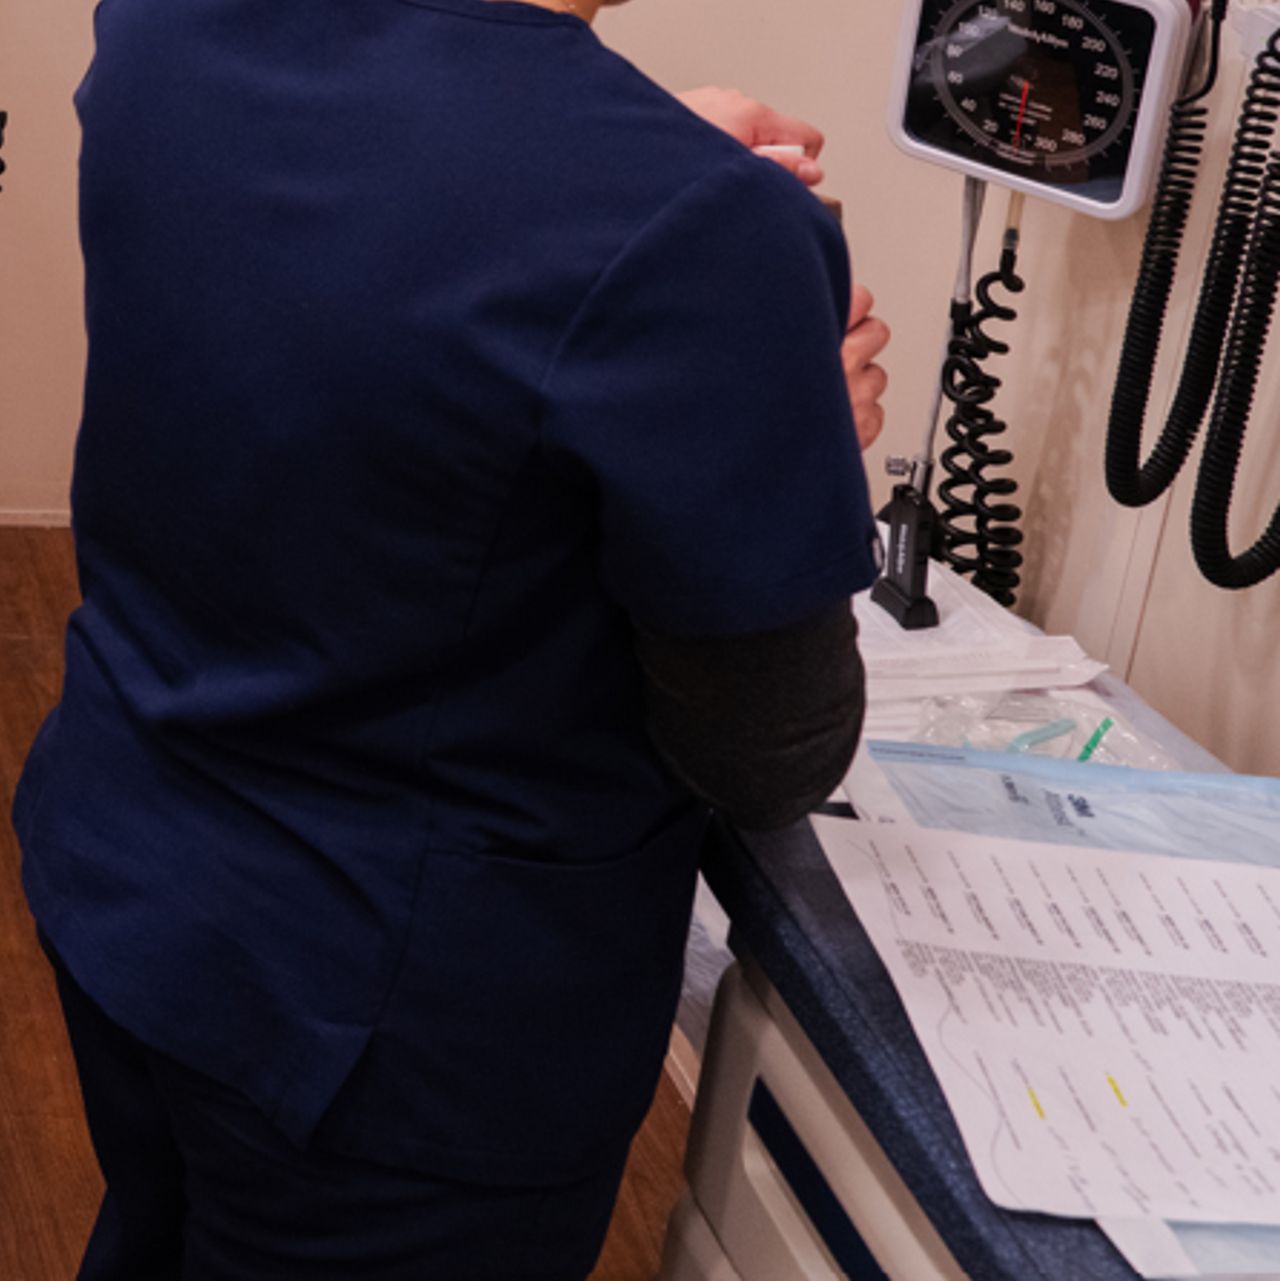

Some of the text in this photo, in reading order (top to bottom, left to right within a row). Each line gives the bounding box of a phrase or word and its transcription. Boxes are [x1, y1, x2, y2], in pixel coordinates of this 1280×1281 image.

[1062, 14, 1084, 31] 180
[1081, 36, 1106, 53] 200
[1094, 62, 1119, 80] 220
[1095, 91, 1120, 107] 240
[982, 118, 999, 133] 20
[1083, 113, 1107, 130] 260
